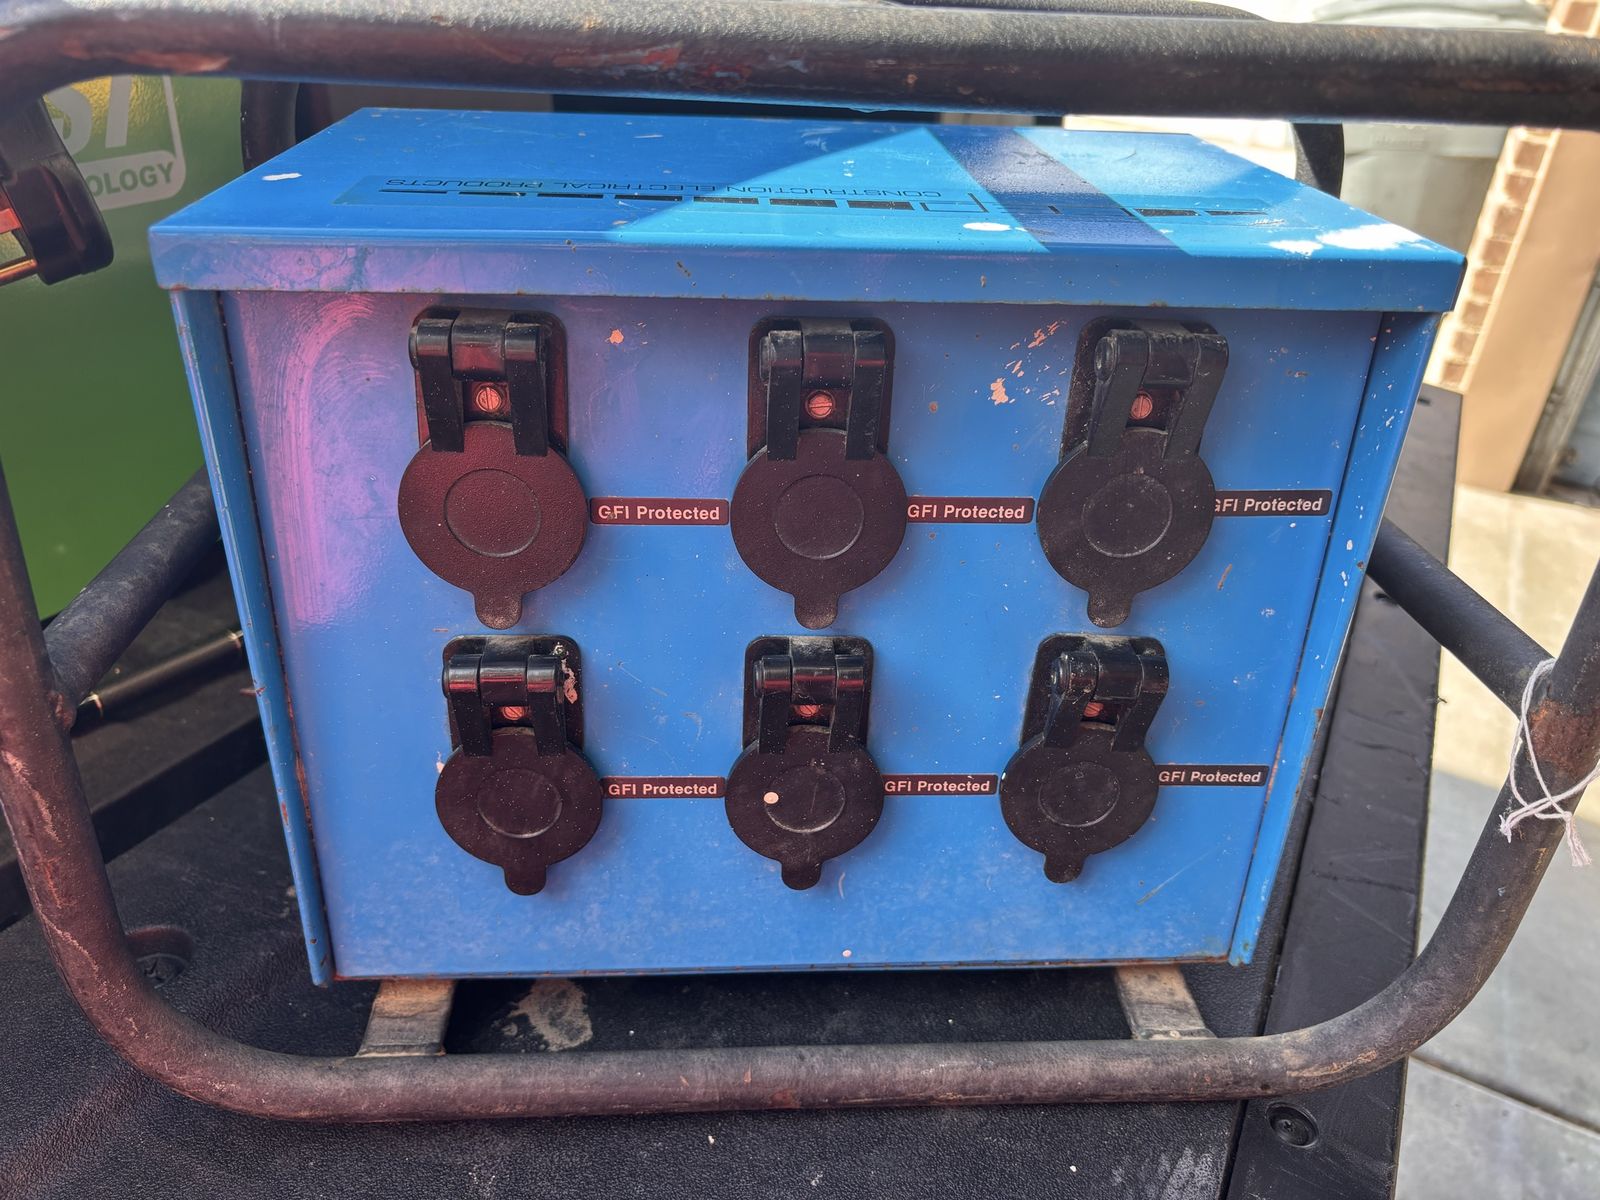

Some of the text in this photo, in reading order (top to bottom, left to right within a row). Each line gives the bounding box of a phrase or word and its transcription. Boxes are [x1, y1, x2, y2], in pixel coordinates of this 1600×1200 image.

[385, 178, 942, 198] CONSTRUCTION ELECTRICAL PRODUCTS
[907, 504, 1025, 519] GFI Protected
[1243, 497, 1323, 512] Protected
[598, 505, 720, 520] GFI Protected
[1158, 770, 1262, 783] GFI Protected
[608, 783, 718, 796] GFI Protected
[884, 780, 990, 792] GFI Protected
